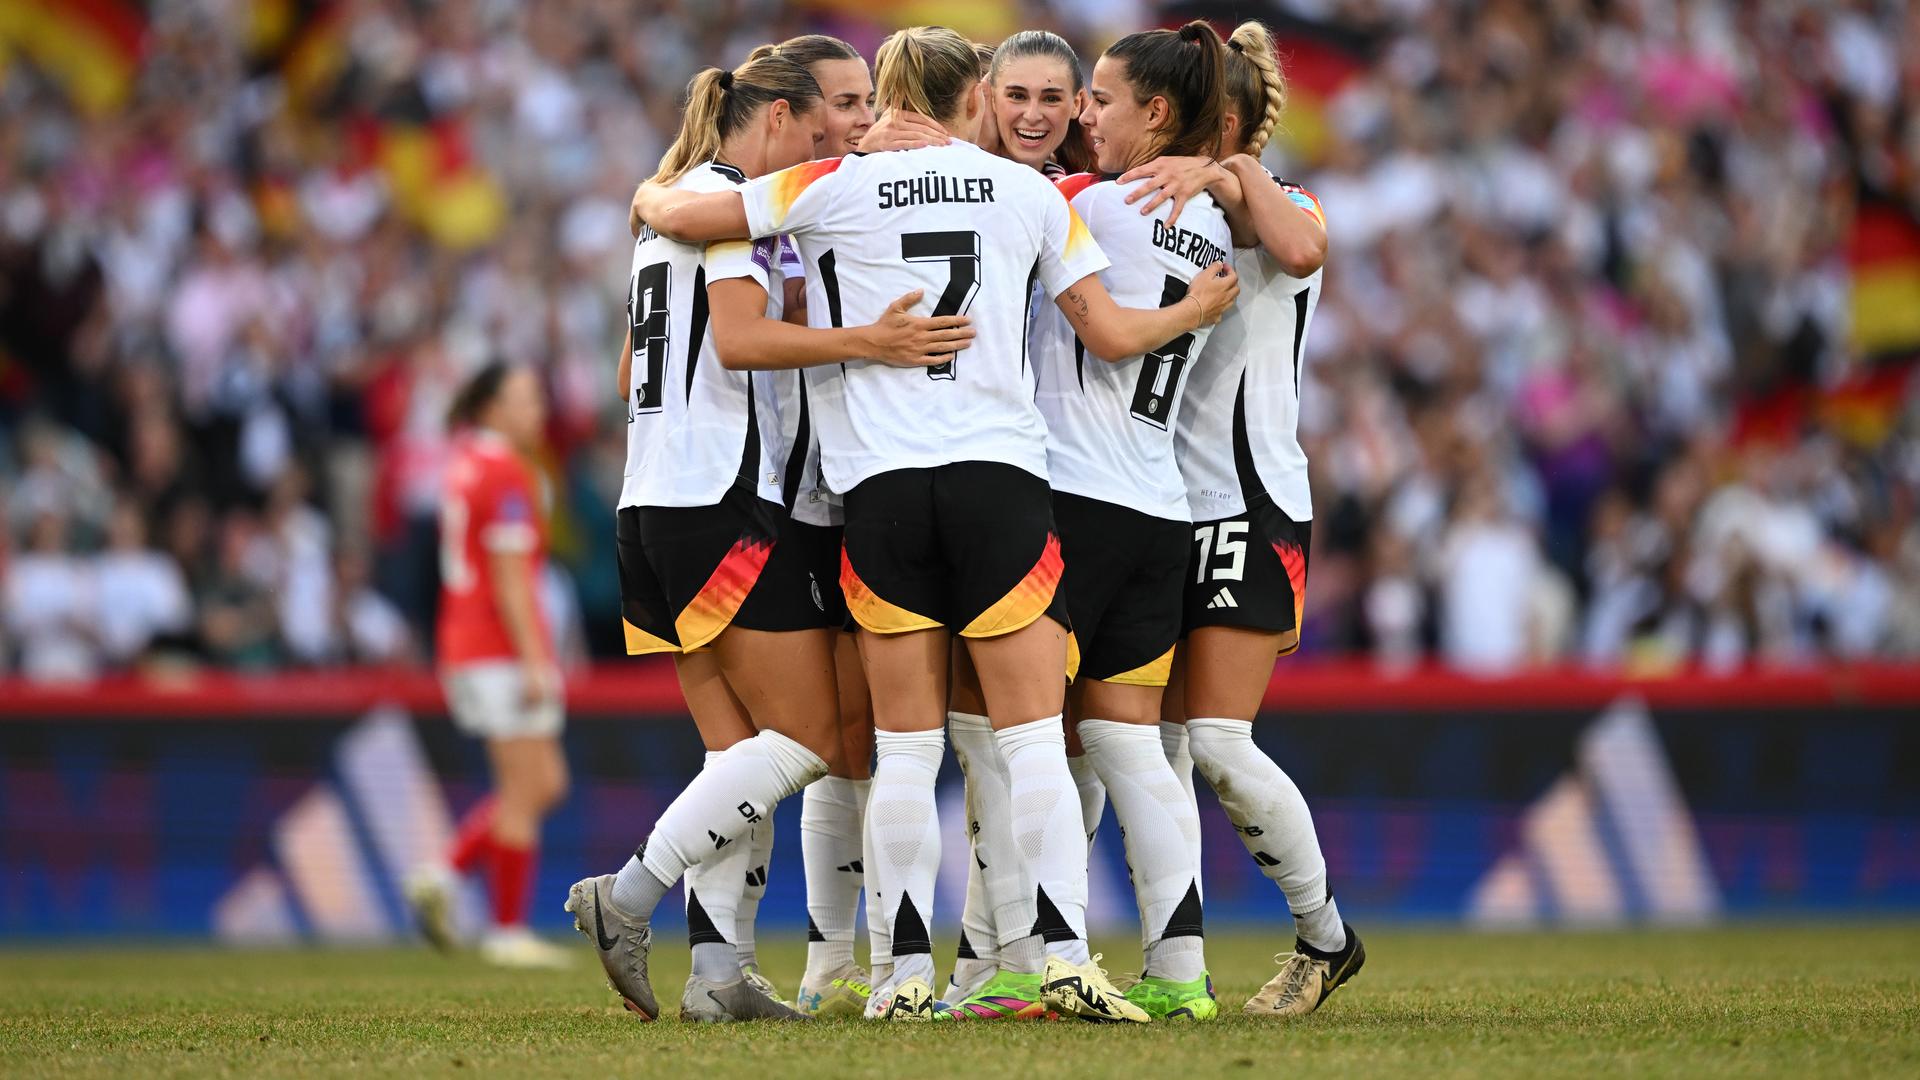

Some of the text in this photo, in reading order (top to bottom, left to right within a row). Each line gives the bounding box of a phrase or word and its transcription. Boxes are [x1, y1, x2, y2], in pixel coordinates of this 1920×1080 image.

[878, 171, 995, 209] SCHÜLLER
[900, 230, 981, 381] 7
[1195, 521, 1249, 584] 15
